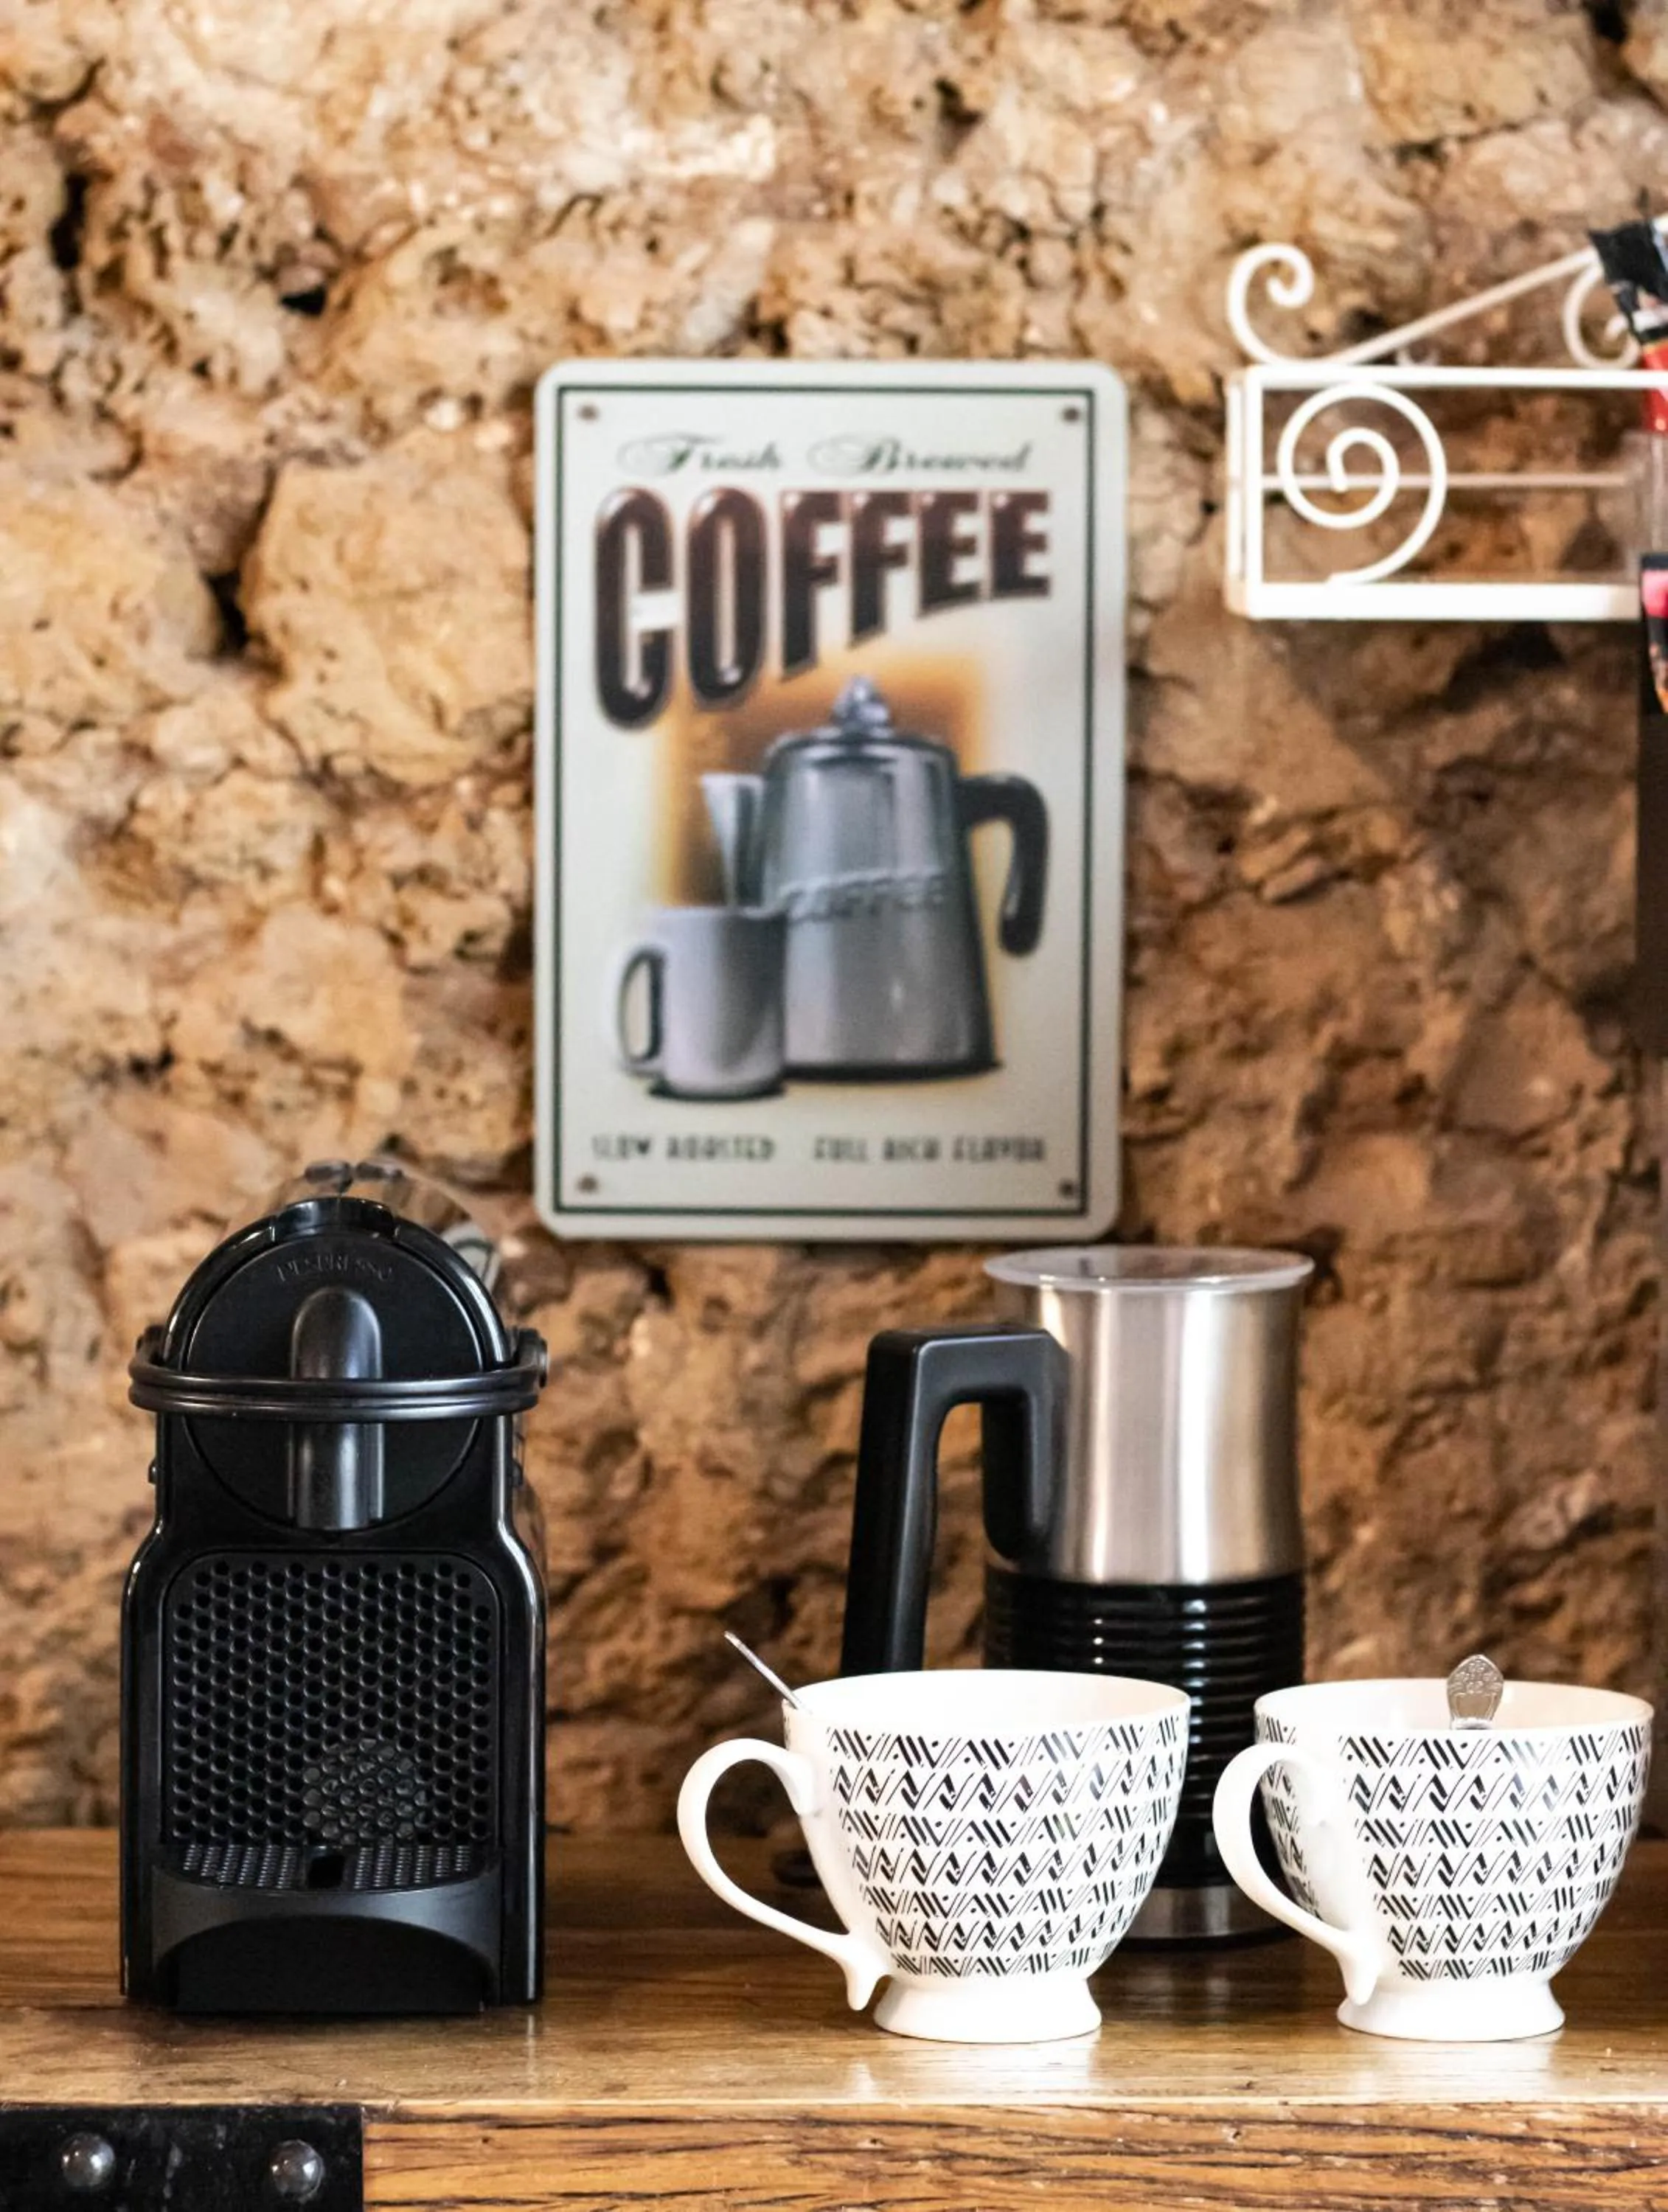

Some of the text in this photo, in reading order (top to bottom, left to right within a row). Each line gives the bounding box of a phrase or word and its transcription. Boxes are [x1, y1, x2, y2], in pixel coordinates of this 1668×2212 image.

[618, 433, 1032, 476] Fresh Brewed
[596, 487, 1050, 728] COFFEE
